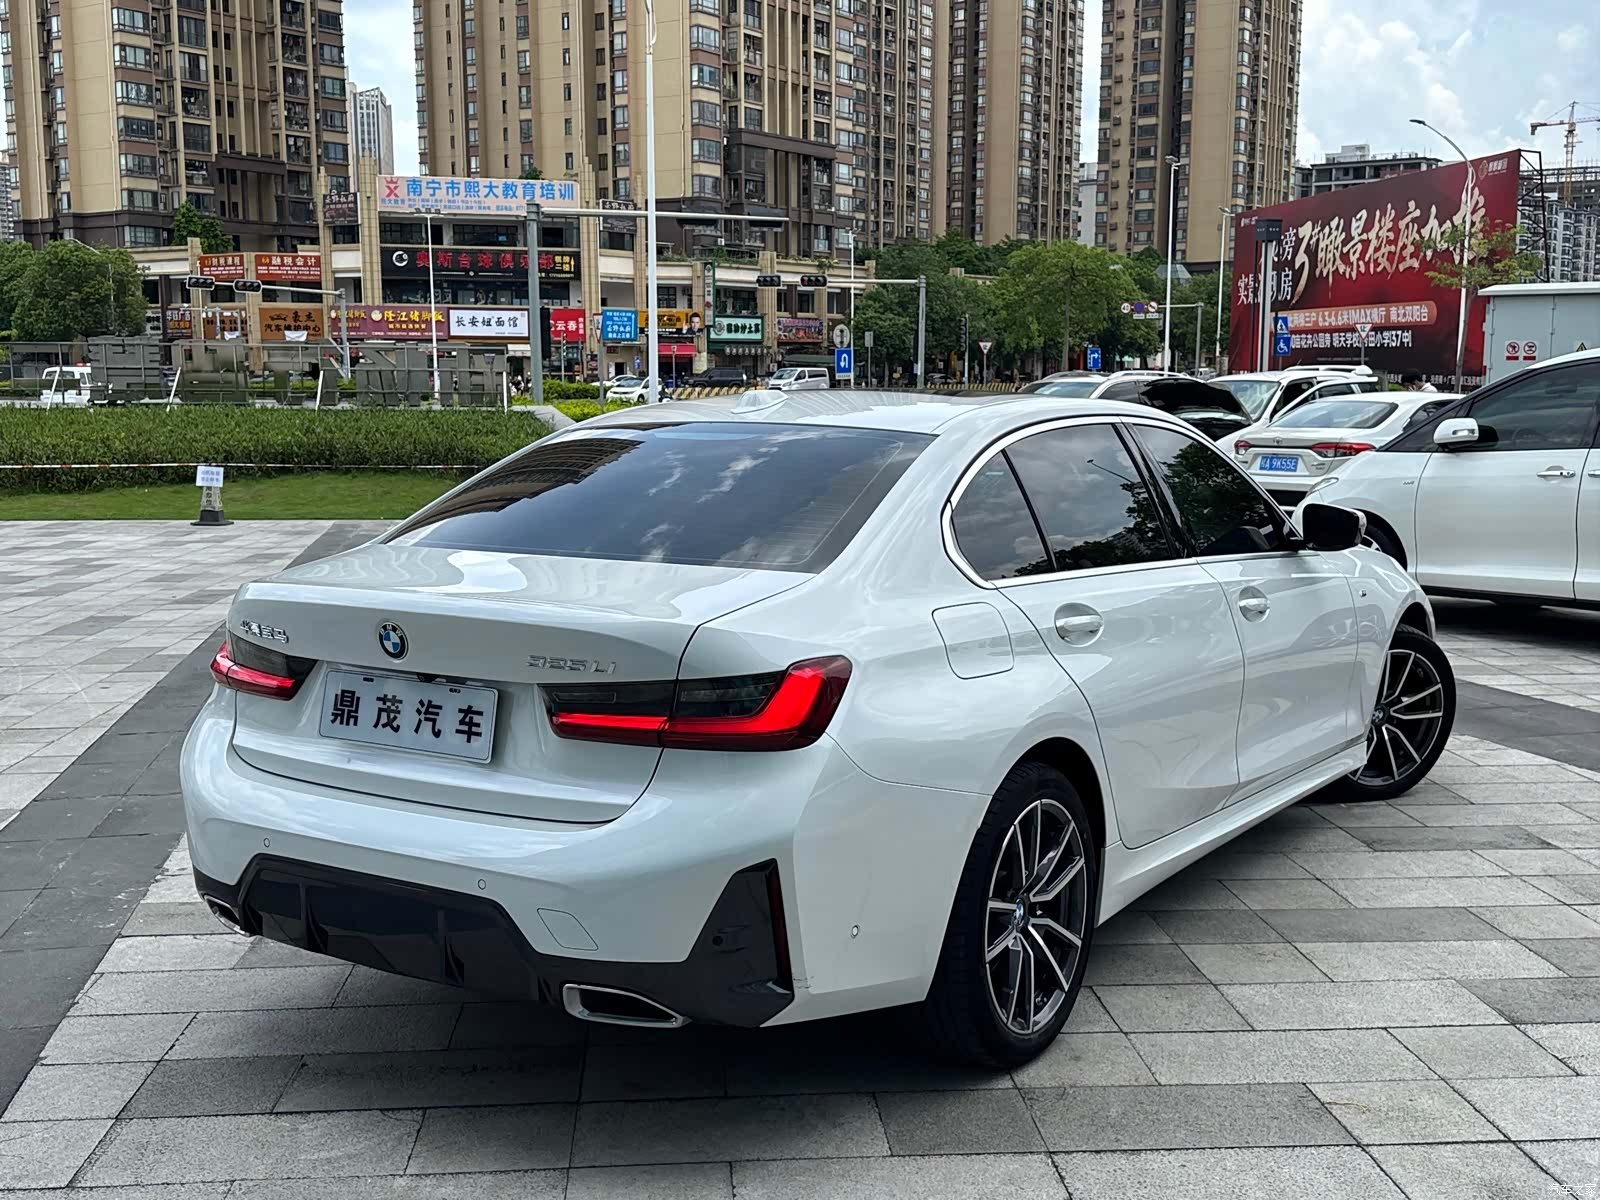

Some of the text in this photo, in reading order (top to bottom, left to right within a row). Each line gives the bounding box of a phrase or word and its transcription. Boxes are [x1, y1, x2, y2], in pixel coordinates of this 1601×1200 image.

[406, 178, 574, 201] 南宁市熙大教育培训
[384, 310, 445, 322] 隆江猪脚饭
[1389, 304, 1428, 323] 南北双阳台
[1289, 333, 1331, 349] 0亩花卉公园旁
[331, 689, 484, 743] 鼎茂汽车
